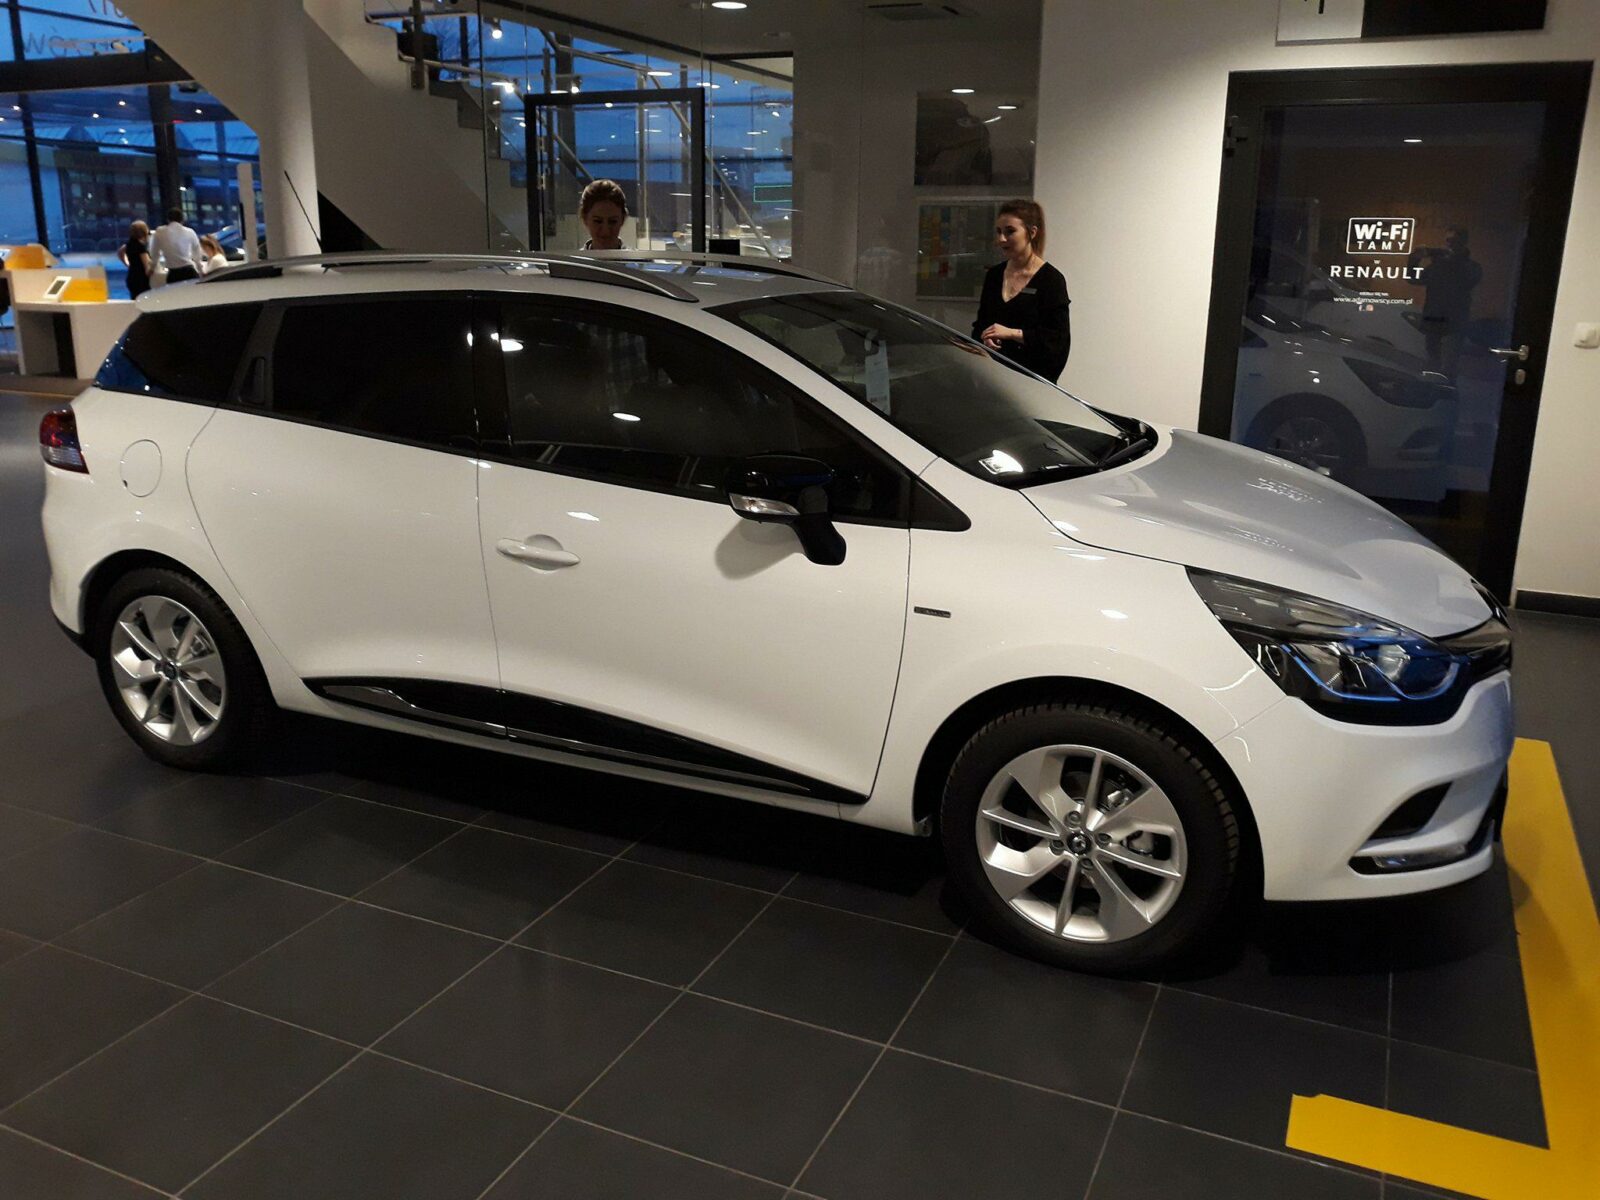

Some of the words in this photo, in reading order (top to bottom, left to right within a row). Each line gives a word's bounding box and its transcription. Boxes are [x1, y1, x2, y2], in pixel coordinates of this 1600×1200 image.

[1354, 221, 1409, 240] Wi-Fi
[1357, 241, 1406, 250] TAMY
[1330, 265, 1424, 279] RENAULT
